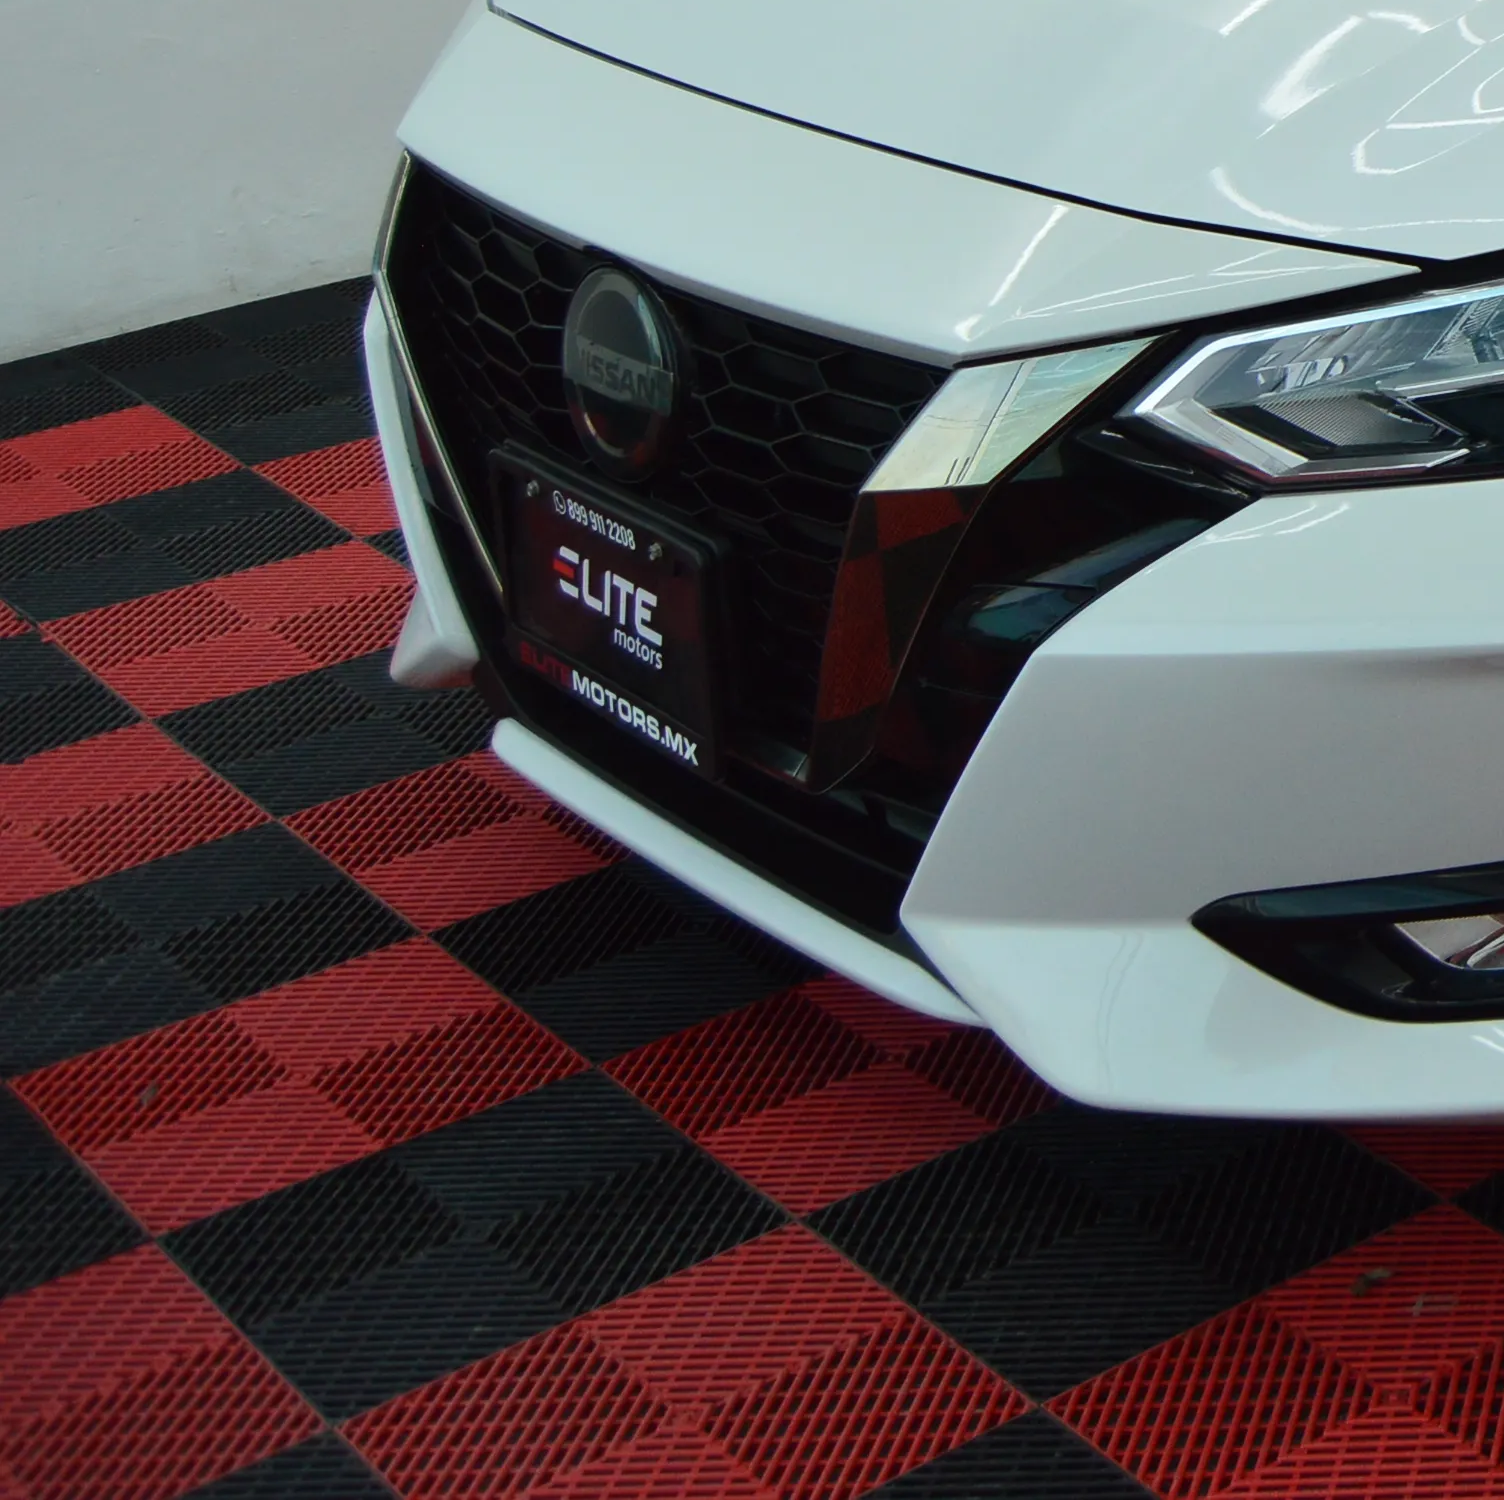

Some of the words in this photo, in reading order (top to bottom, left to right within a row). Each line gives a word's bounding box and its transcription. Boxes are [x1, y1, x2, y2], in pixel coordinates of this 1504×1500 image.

[567, 498, 588, 526] 899
[589, 509, 606, 536] 911
[606, 518, 636, 551] 2208
[553, 545, 663, 650] ELITE
[614, 628, 663, 670] motors
